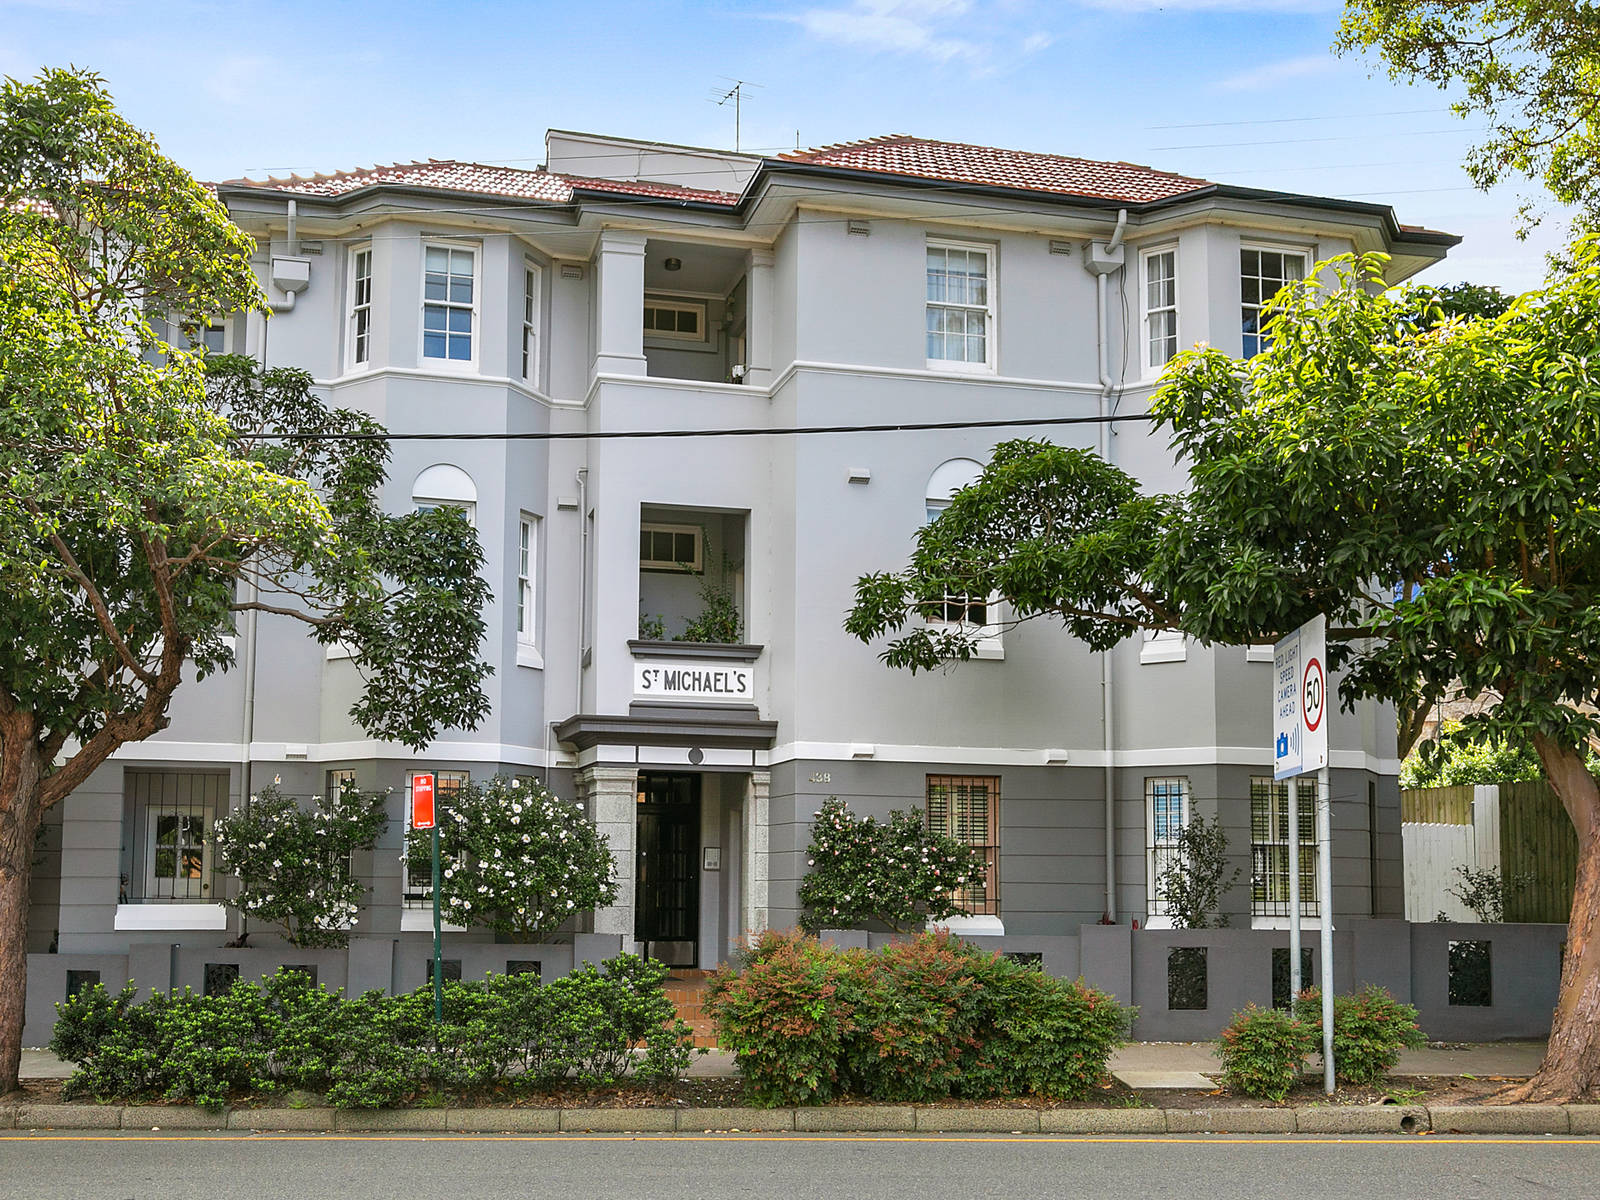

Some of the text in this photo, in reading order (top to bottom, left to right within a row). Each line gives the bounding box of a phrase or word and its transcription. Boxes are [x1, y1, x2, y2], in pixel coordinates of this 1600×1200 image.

[664, 669, 746, 693] MICHAEL'S
[1280, 665, 1294, 684] SPEED
[1278, 683, 1296, 702] CAMERA
[1306, 677, 1320, 712] 50
[1279, 701, 1295, 719] AHEAD
